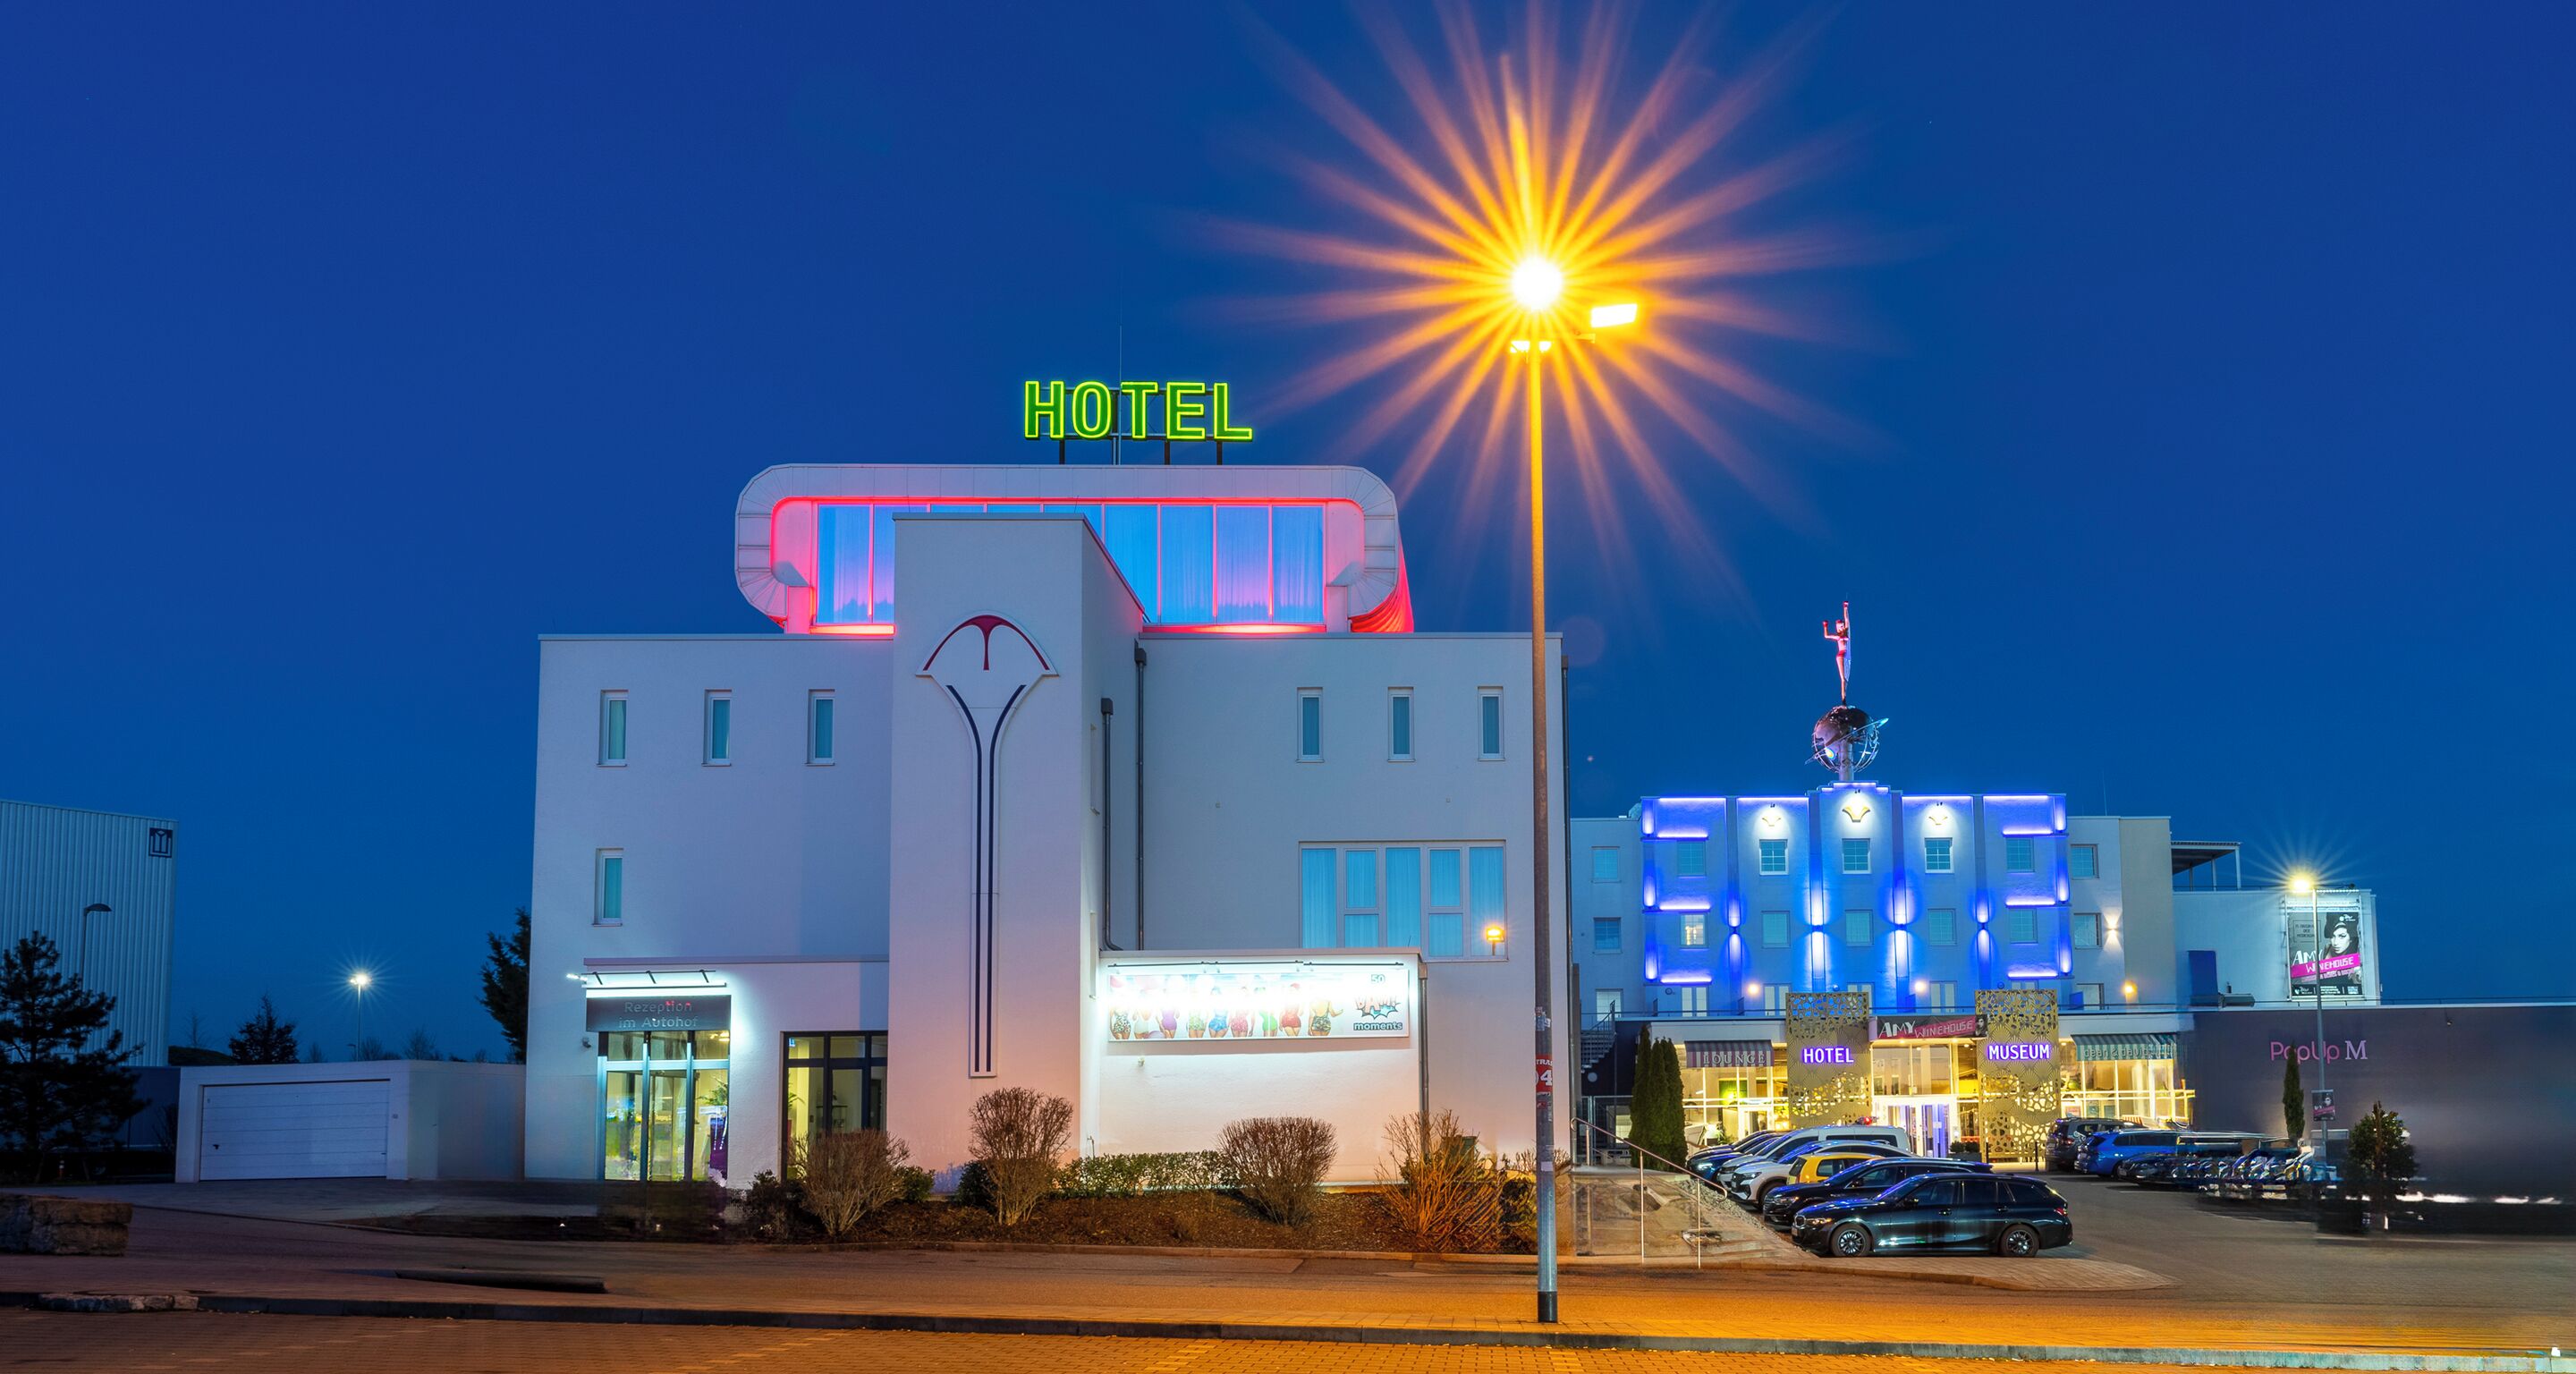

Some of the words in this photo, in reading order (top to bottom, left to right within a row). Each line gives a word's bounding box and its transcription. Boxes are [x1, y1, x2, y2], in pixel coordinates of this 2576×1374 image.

[1025, 381, 1252, 439] HOTEL
[2306, 956, 2354, 973] WNEHOUSE
[1371, 973, 1385, 984] 50
[624, 1001, 692, 1014] Rezeption
[619, 1017, 635, 1028] im
[641, 1016, 698, 1028] Autohof
[1353, 1022, 1403, 1030] moments
[1878, 1021, 1916, 1038] AMY
[1914, 1020, 1973, 1038] WINEHOUSE
[1803, 1047, 1854, 1064] HOTEL
[1988, 1045, 2050, 1060] MUSEUM
[2112, 1047, 2119, 1056] &
[2345, 1040, 2368, 1060] M
[1703, 1054, 1766, 1064] LOUNGE
